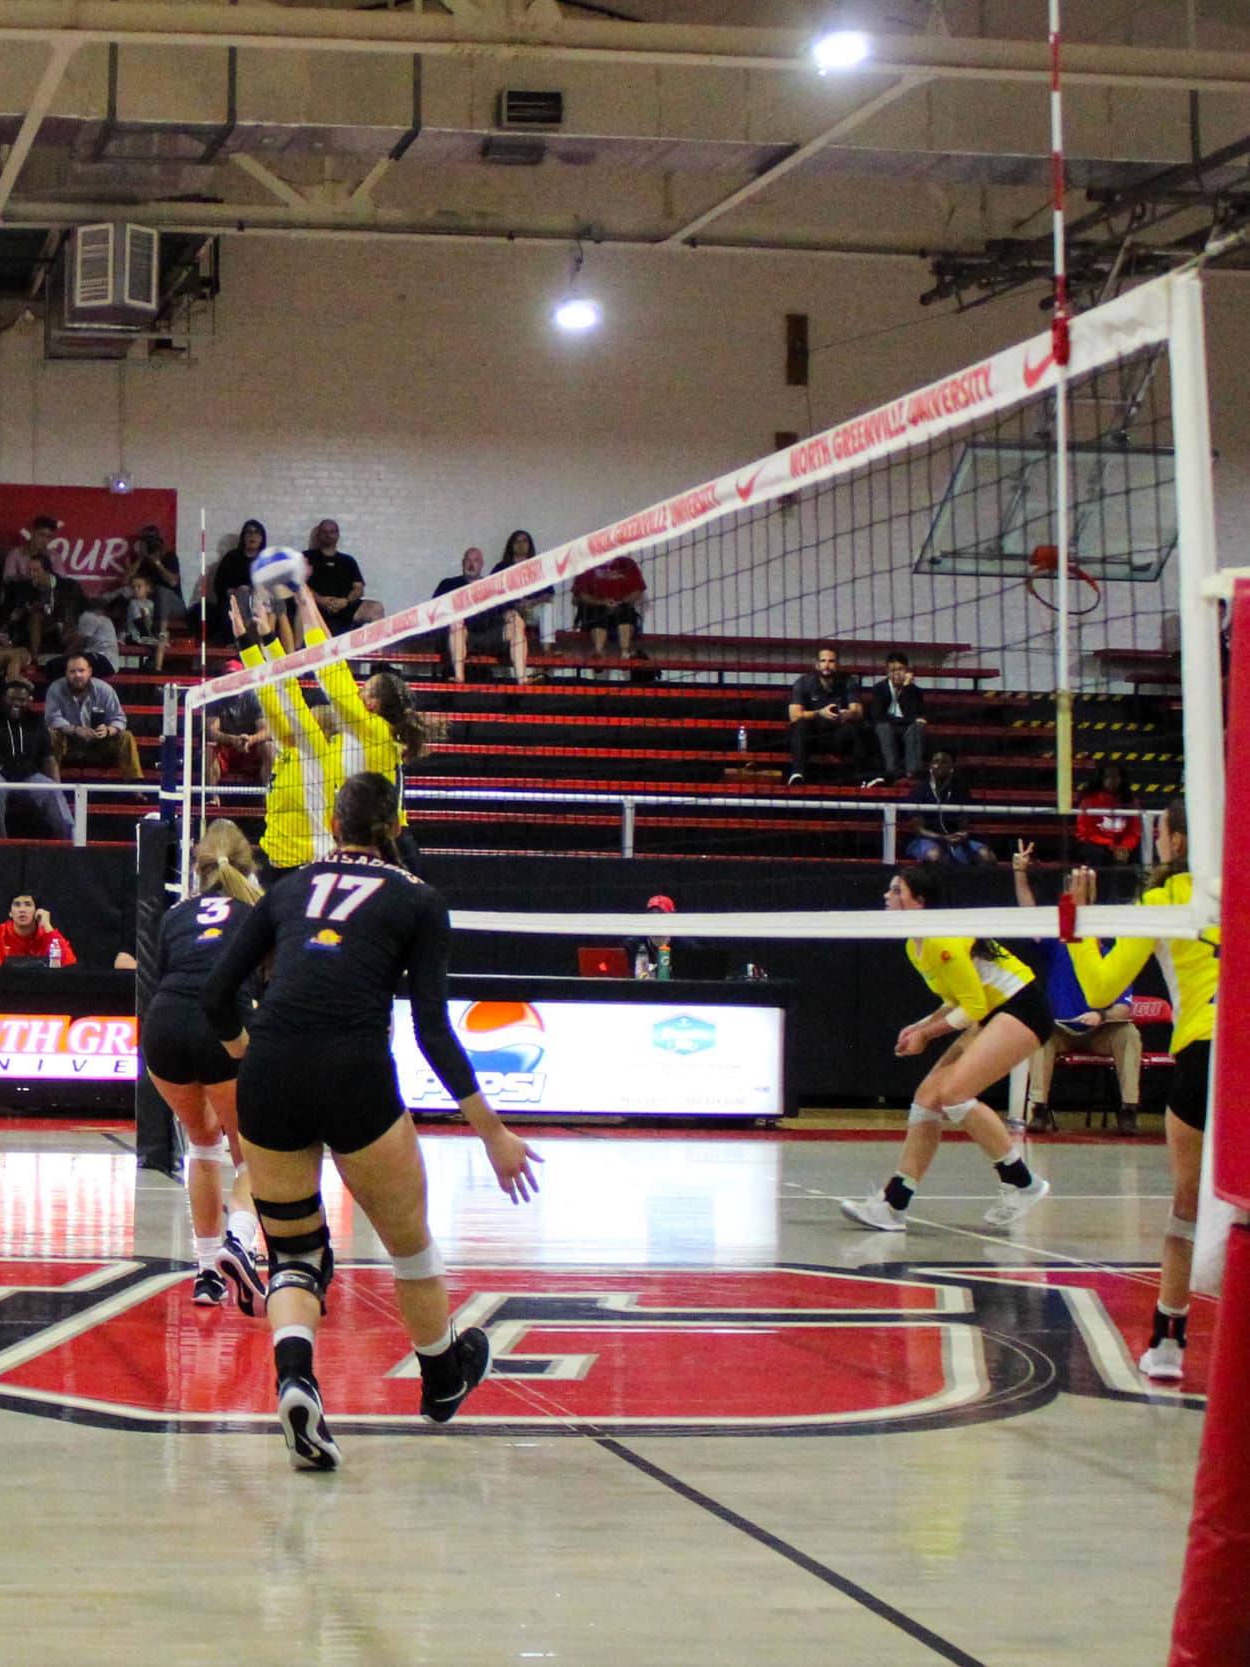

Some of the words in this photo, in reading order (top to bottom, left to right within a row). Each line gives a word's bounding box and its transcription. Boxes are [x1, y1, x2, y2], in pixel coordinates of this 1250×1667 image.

[789, 436, 833, 479] NORTH
[832, 402, 907, 461] GREENVILLE
[906, 365, 993, 427] UNIVERSITY
[196, 897, 233, 925] 3
[305, 873, 386, 921] 17
